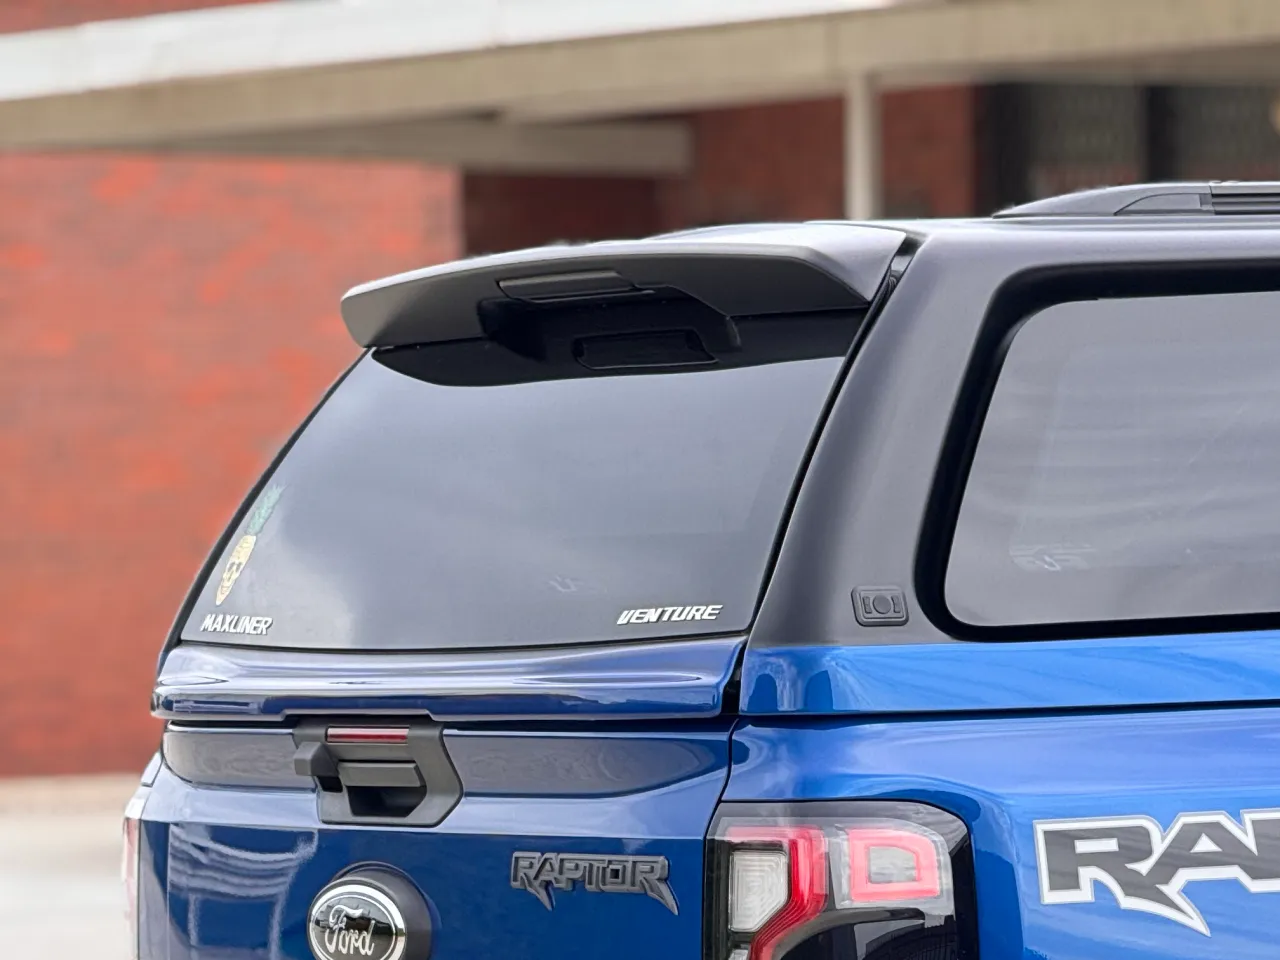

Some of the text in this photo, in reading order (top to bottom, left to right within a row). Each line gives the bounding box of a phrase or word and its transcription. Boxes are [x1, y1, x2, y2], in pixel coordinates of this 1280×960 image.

[200, 613, 273, 635] MAXLINER
[616, 604, 723, 625] VENTURE
[510, 851, 680, 916] RAPTOR
[324, 904, 375, 956] Ford
